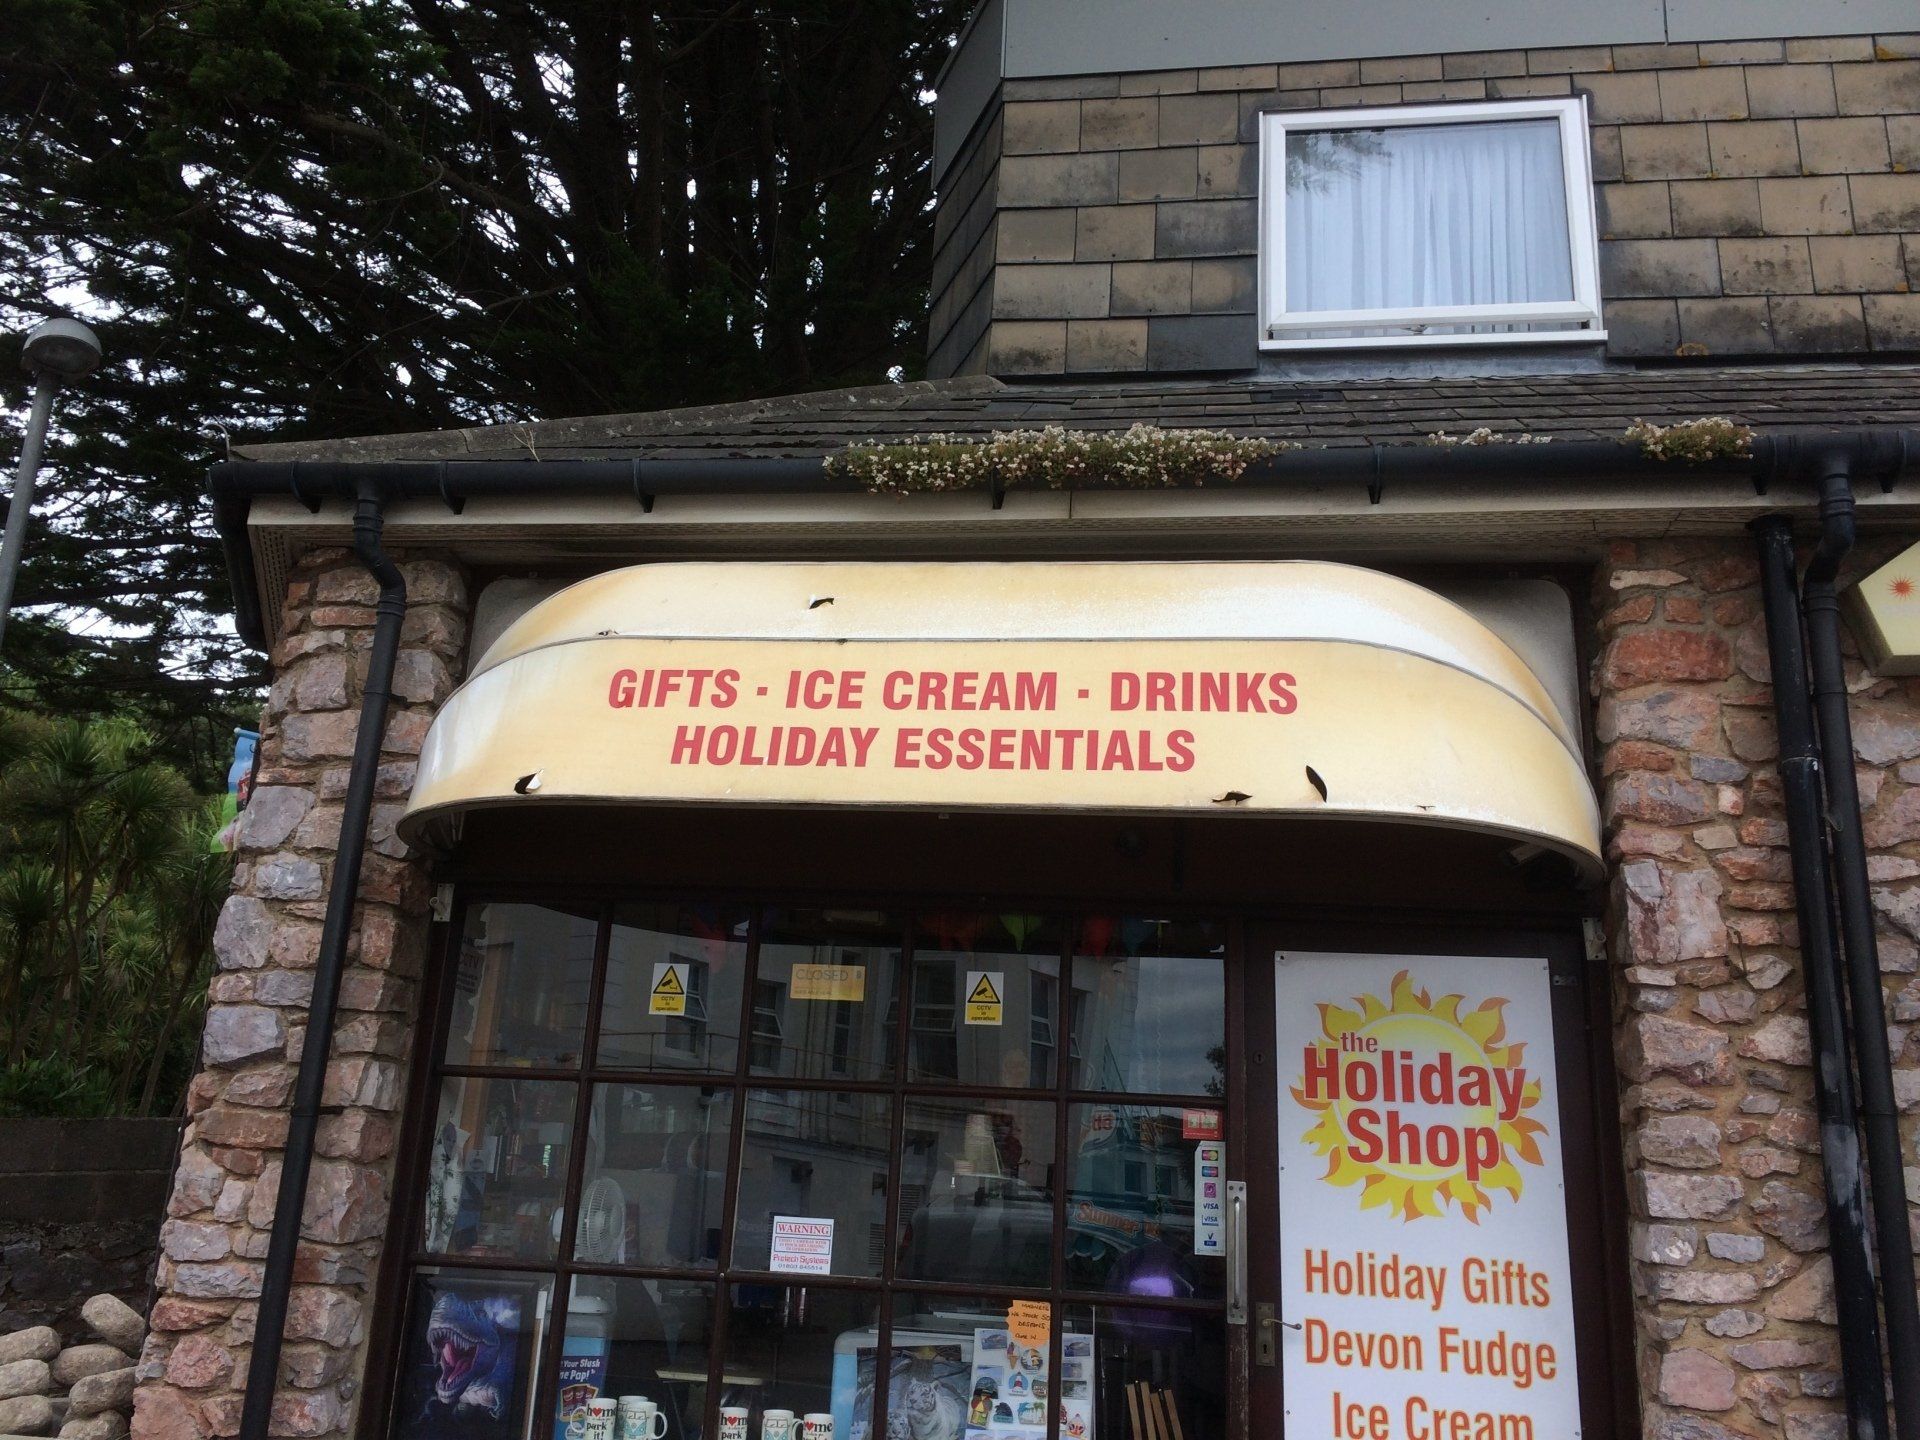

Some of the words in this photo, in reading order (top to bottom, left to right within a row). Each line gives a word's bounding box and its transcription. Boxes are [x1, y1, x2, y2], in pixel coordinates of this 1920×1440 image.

[608, 669, 741, 709] GIFTS
[785, 670, 866, 709] ICE
[883, 671, 1058, 711] CREAM
[1110, 672, 1298, 714] DRINKS
[671, 725, 880, 767] HOLIDAY
[895, 728, 1195, 772] ESSENTIALS
[796, 969, 849, 982] CLOSED
[1340, 1032, 1378, 1053] the
[1304, 1047, 1526, 1121] Holiday
[1347, 1108, 1500, 1181] Shop
[778, 1224, 829, 1235] WARNING
[800, 1256, 829, 1264] Systems
[1305, 1249, 1447, 1310] Holiday
[1462, 1257, 1550, 1307] Gifts
[580, 1359, 600, 1367] Slush
[1305, 1319, 1423, 1370] Devon
[1439, 1327, 1556, 1388] Fudge
[587, 1422, 606, 1431] park
[1333, 1392, 1389, 1440] Ice
[1405, 1396, 1533, 1440] Cream
[721, 1430, 743, 1440] park
